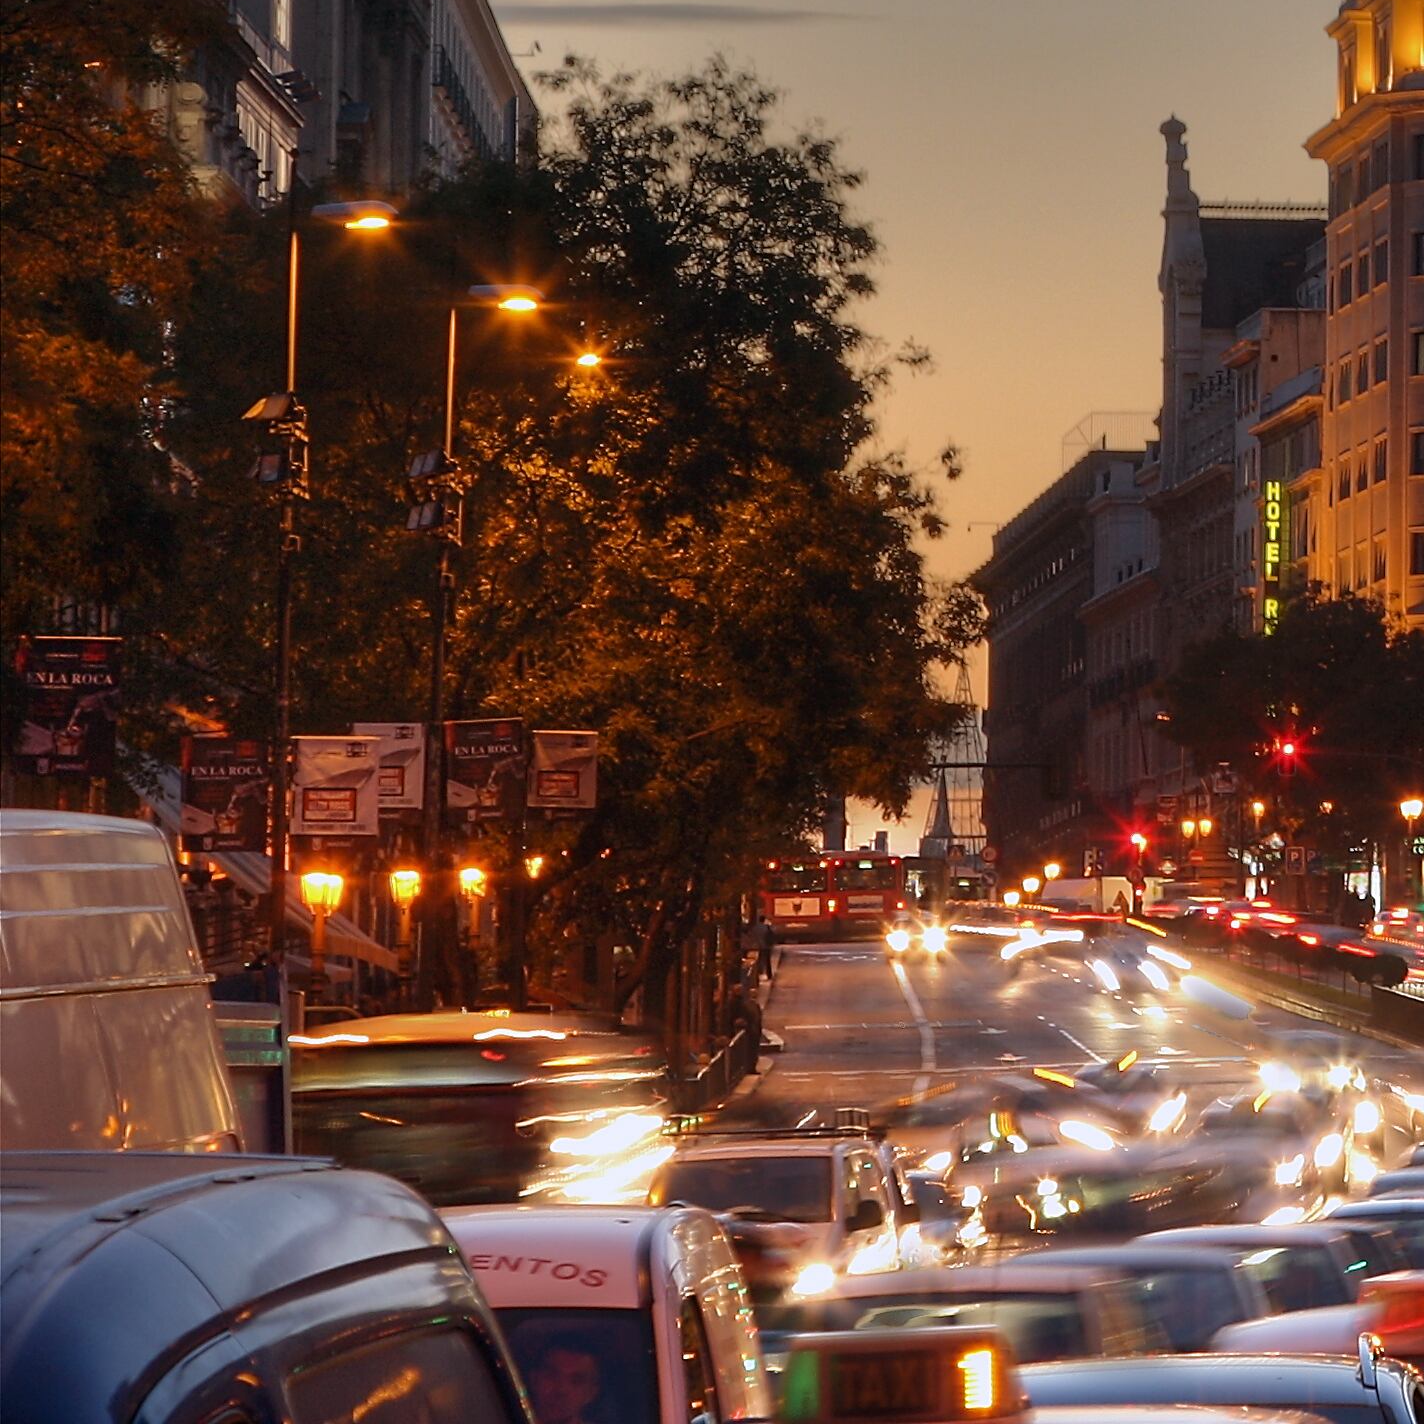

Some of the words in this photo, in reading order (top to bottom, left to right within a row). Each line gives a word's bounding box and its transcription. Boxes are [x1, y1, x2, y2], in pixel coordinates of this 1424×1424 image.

[1265, 481, 1280, 581] HOTEL
[72, 673, 113, 685] ROCA
[488, 744, 519, 754] ROCA
[228, 766, 263, 775] ROCA
